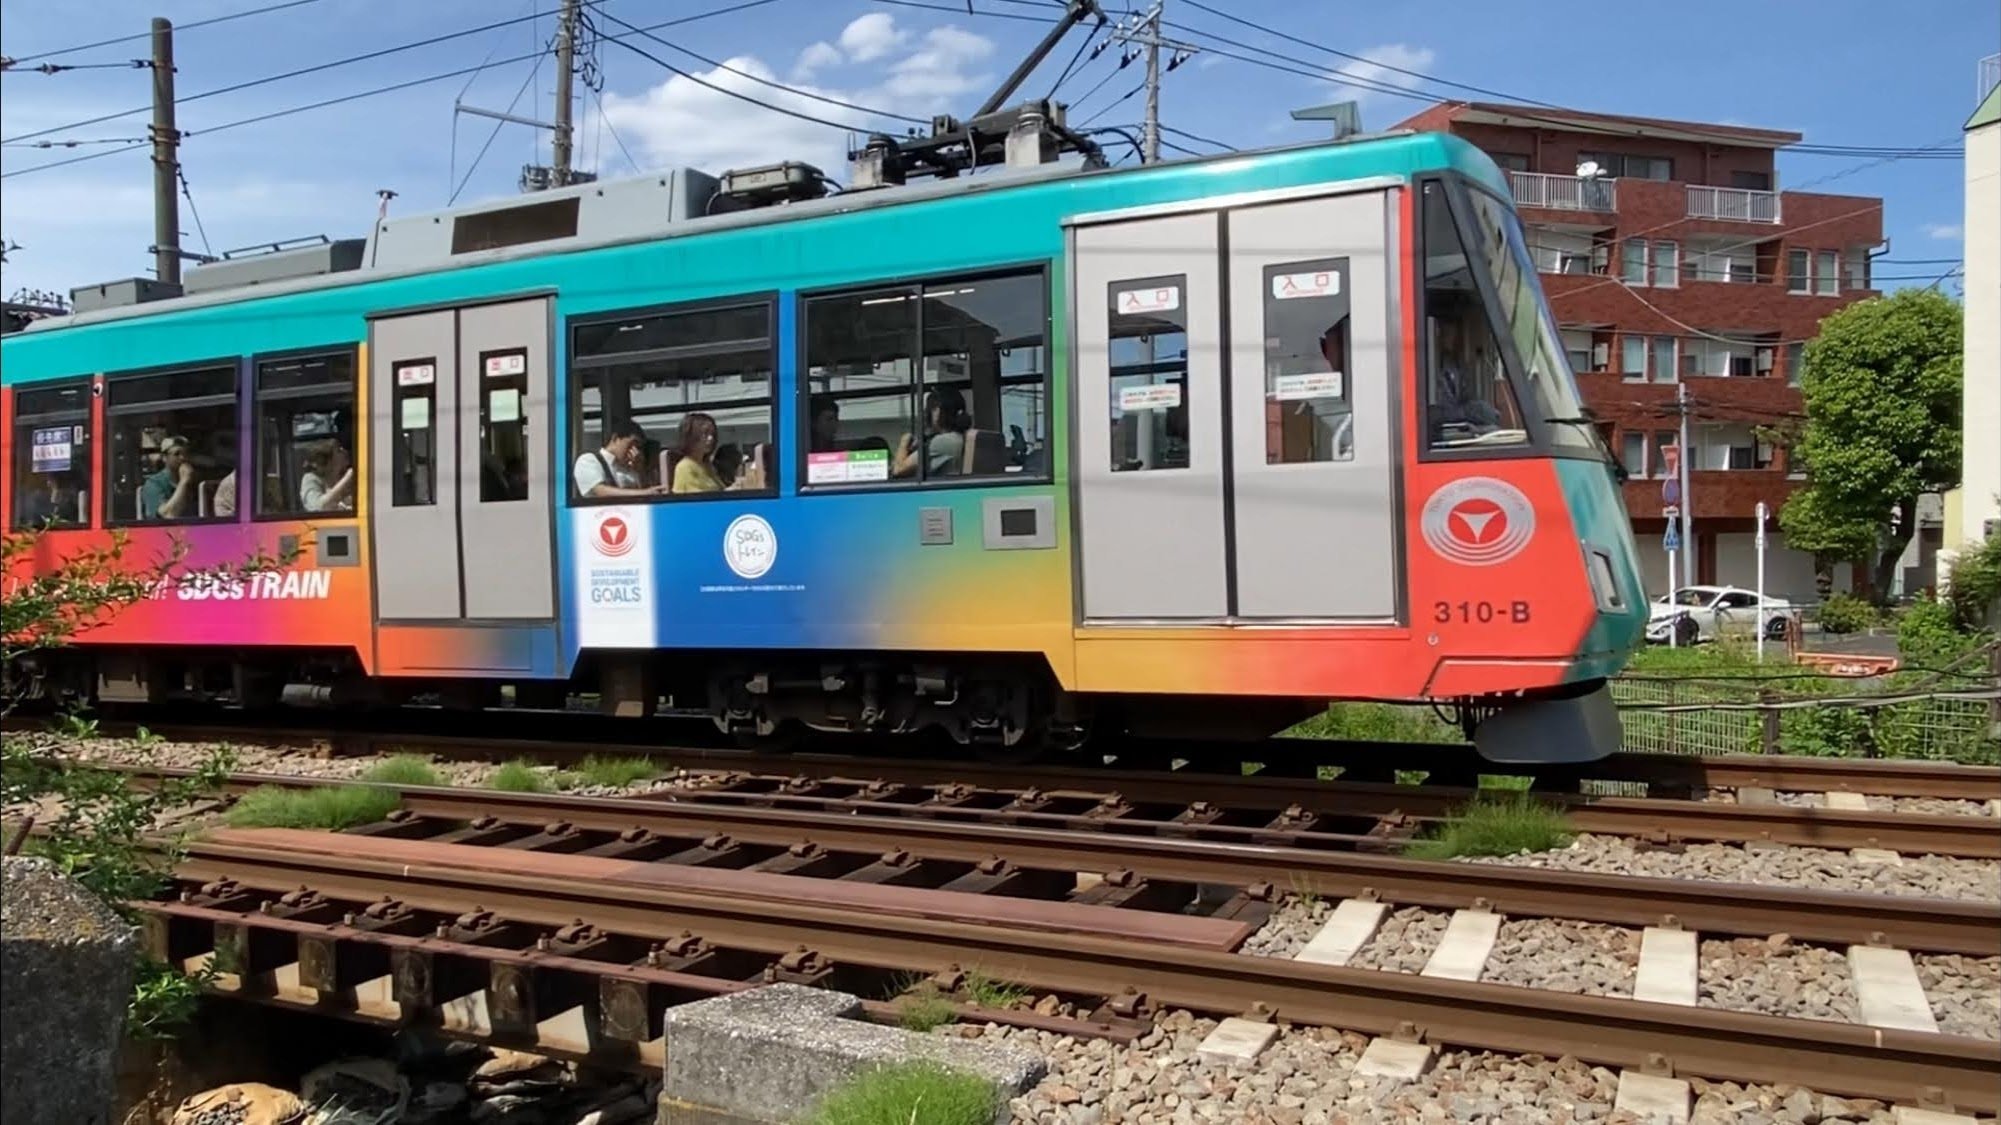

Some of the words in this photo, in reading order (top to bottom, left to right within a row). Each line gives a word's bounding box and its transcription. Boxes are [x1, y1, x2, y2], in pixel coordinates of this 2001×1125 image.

[1283, 274, 1329, 289] 入口
[1126, 289, 1168, 305] 入口
[250, 570, 330, 600] TRAIN
[591, 587, 641, 602] GOALS
[1434, 601, 1531, 623] 310-B
